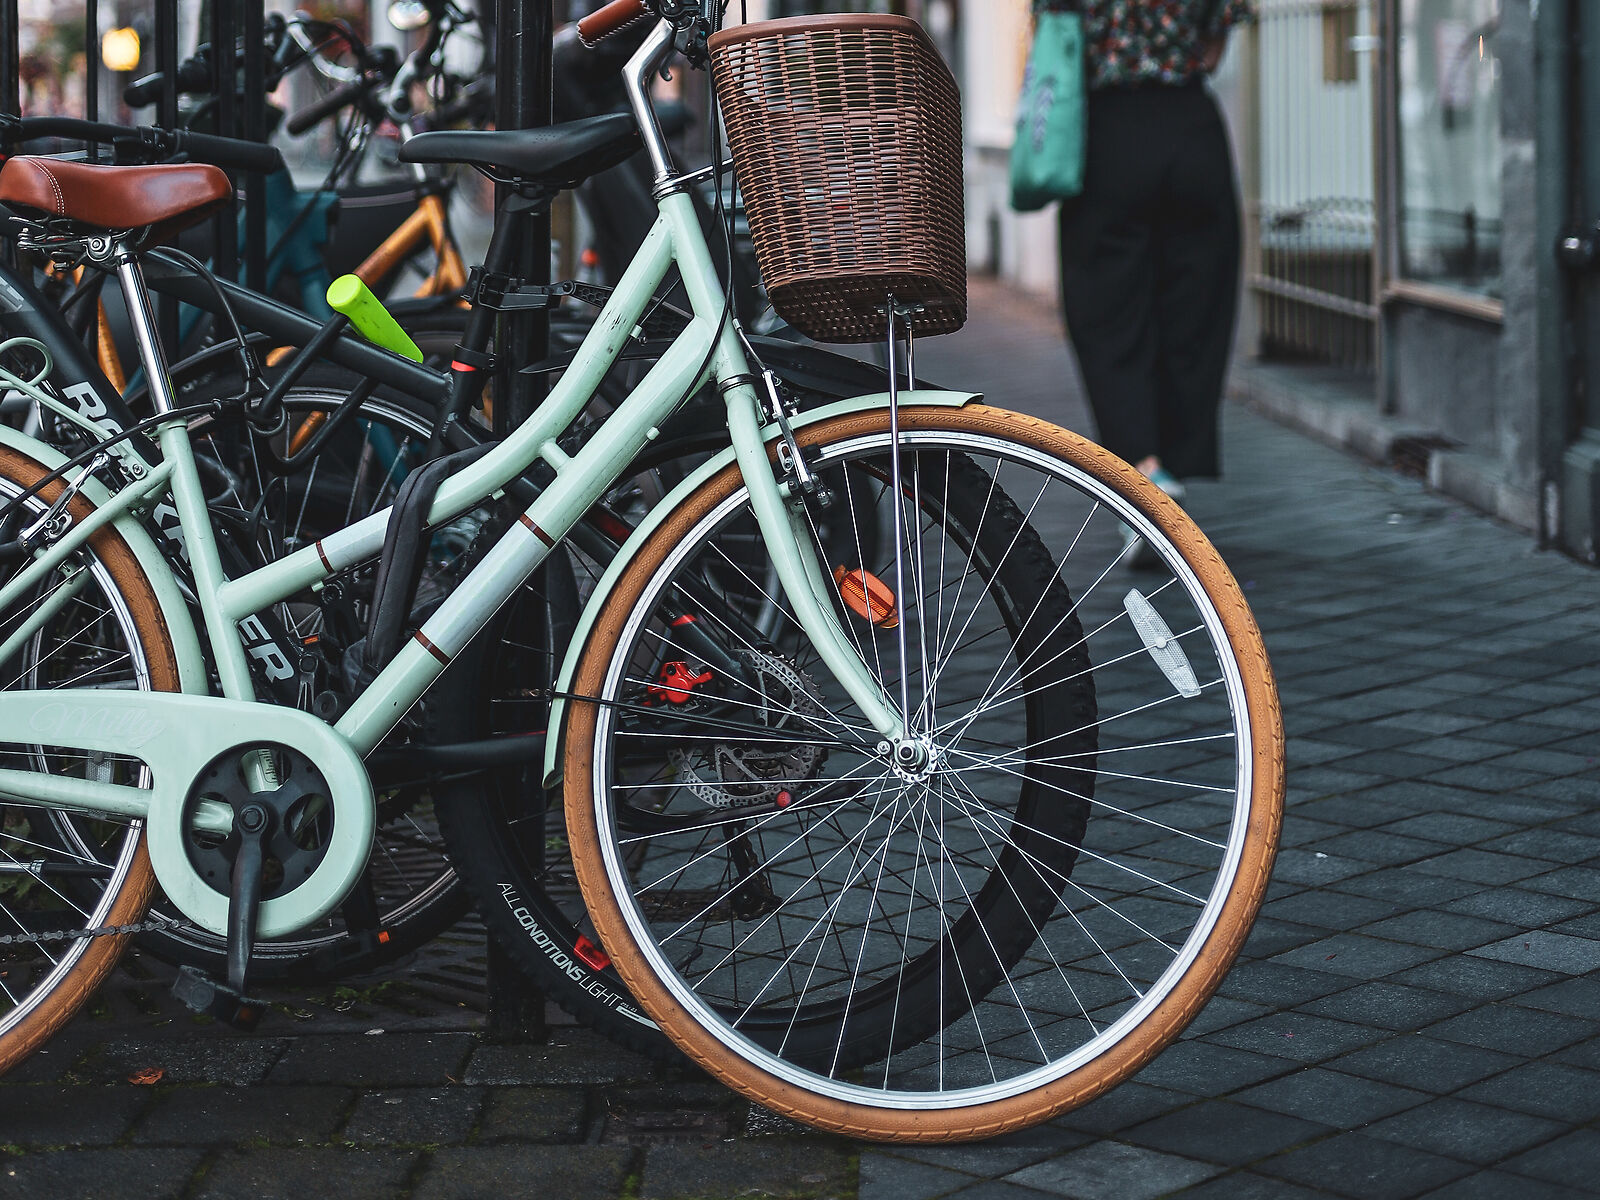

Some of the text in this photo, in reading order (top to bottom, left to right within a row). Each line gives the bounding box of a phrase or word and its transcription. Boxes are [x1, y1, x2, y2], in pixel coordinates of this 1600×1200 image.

[28, 702, 168, 750] Milly
[496, 882, 623, 1008] ALL CONDITIONS LIGHT
